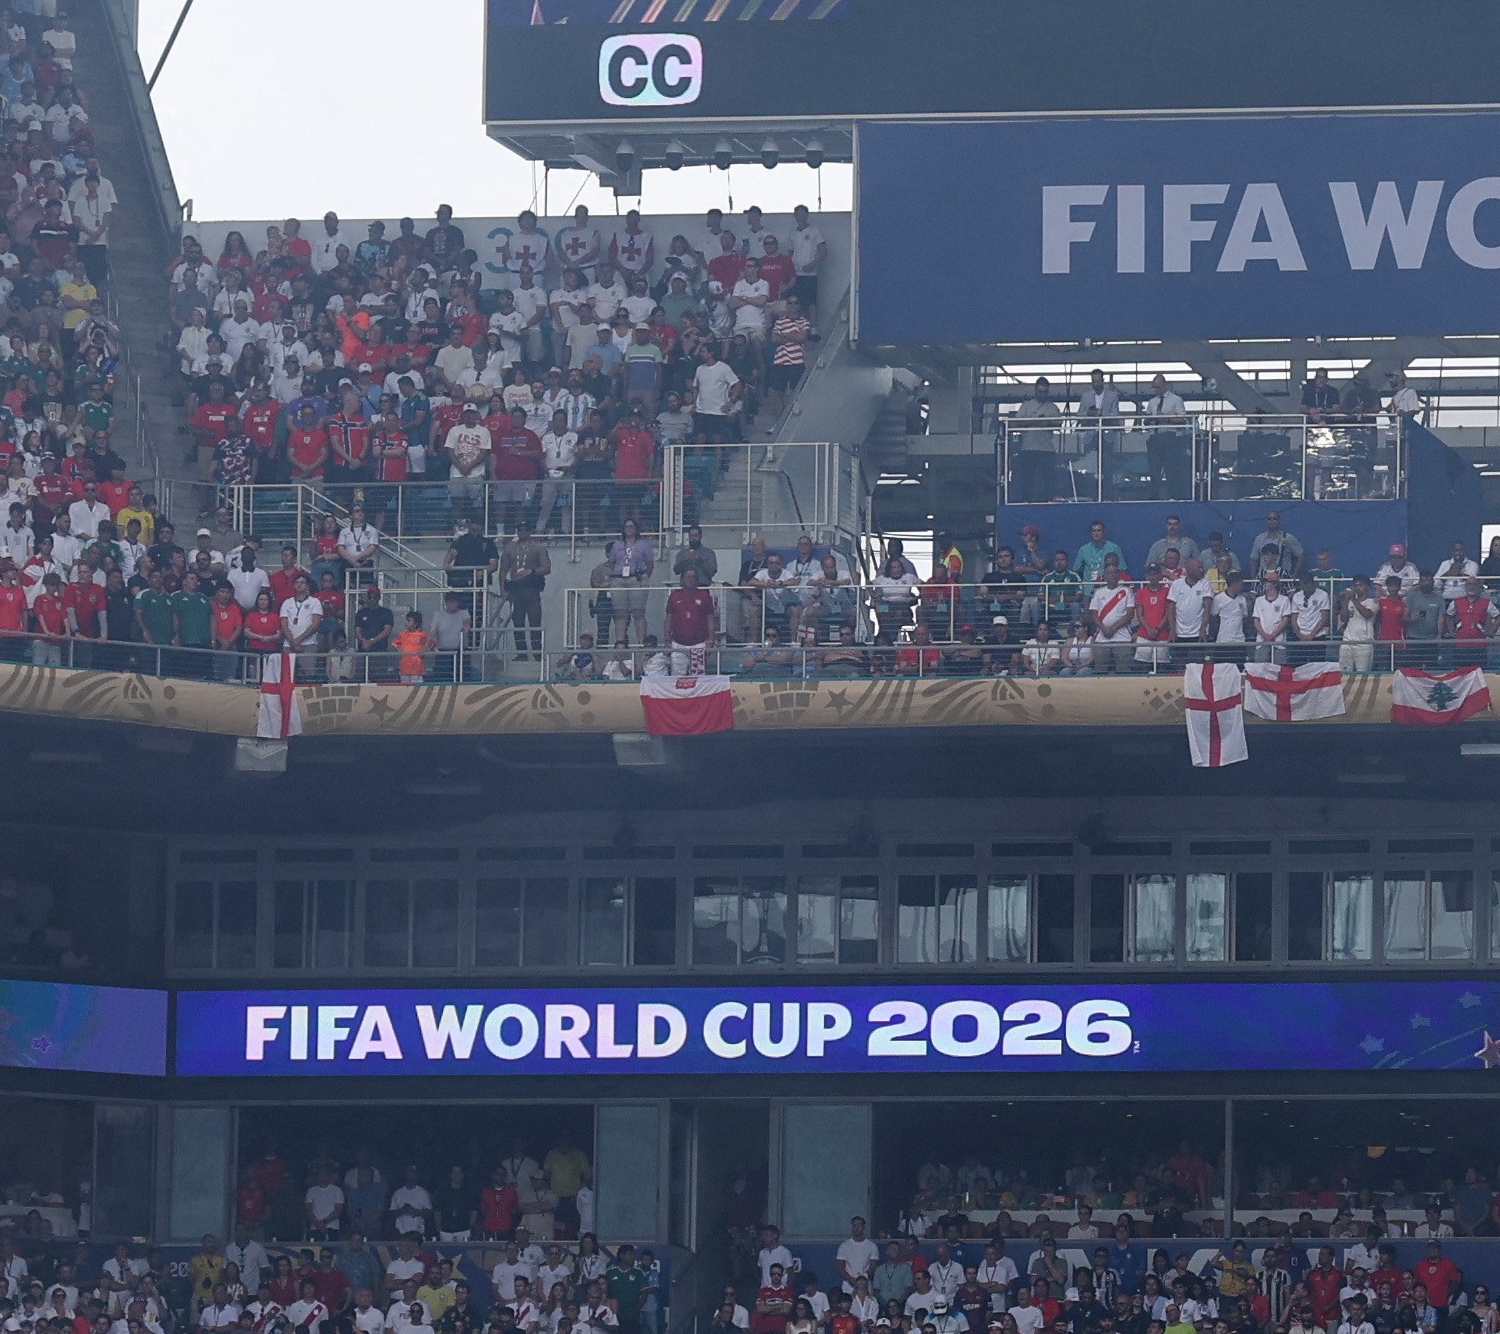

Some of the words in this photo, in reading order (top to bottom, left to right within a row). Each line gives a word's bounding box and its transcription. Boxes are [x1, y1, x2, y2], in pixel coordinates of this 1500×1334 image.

[608, 44, 693, 99] CC
[1042, 183, 1308, 274] FIFA
[245, 1004, 402, 1061] FIFA
[415, 1002, 688, 1061] WORLD
[702, 1000, 852, 1059] CUP
[868, 999, 1133, 1057] 2026
